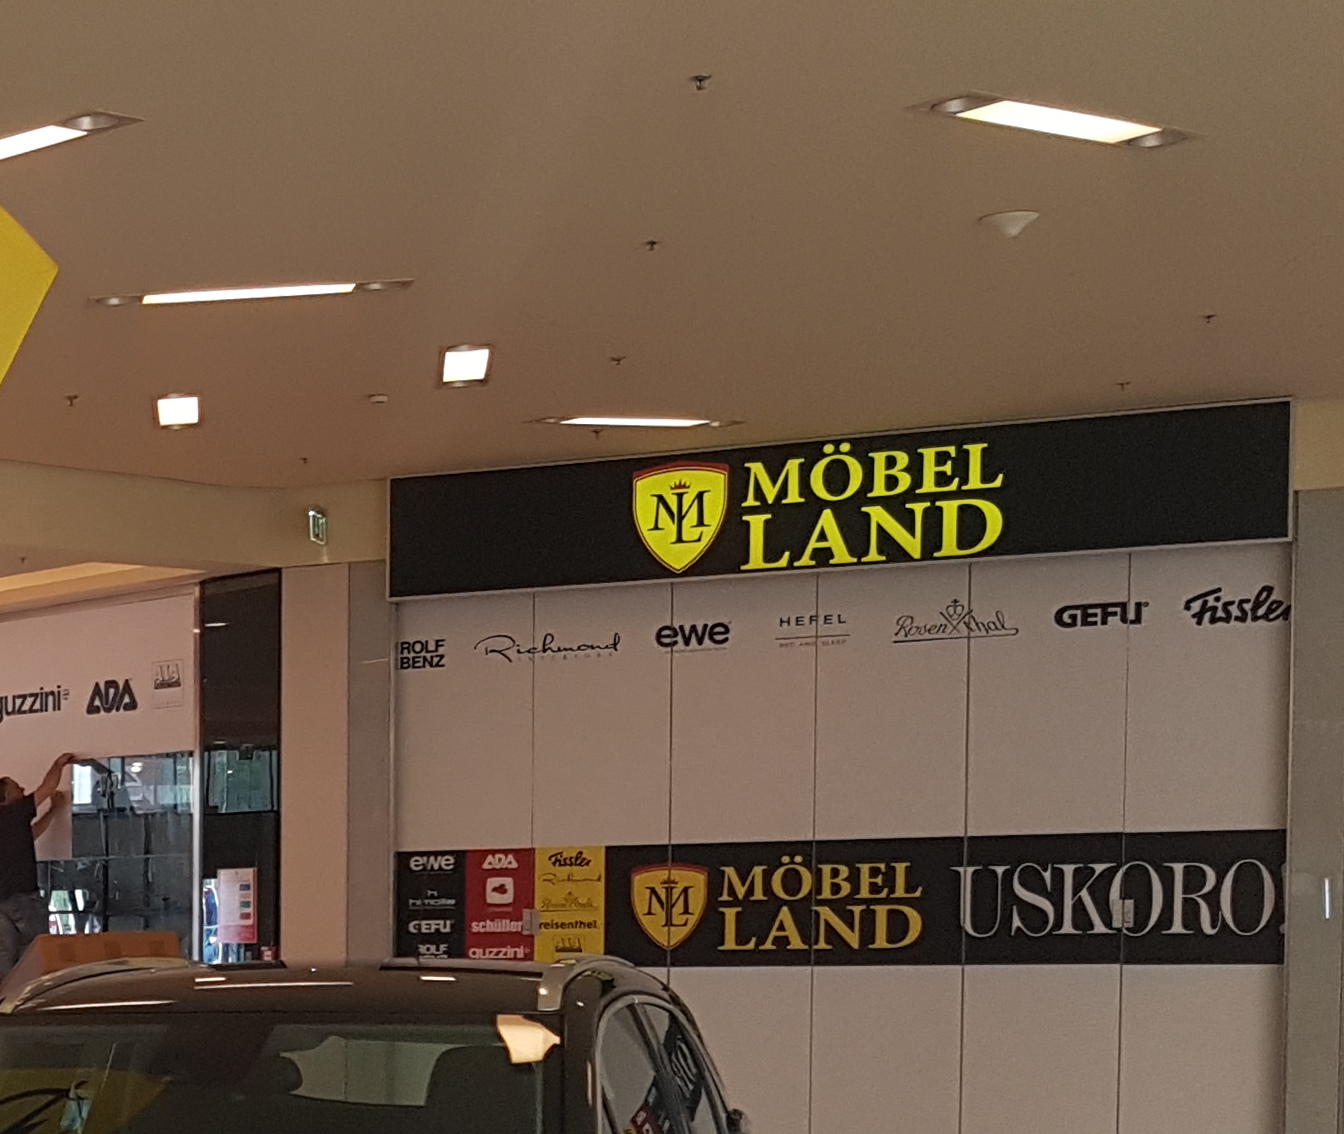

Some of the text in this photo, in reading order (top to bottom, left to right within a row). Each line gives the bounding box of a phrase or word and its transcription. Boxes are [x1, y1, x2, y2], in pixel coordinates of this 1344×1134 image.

[741, 442, 1004, 508] MÖBEL
[740, 498, 1004, 571] LAND
[779, 614, 847, 627] HEFEL
[1053, 601, 1143, 628] GEFU
[399, 639, 446, 655] ROLF
[474, 632, 621, 663] Richmond
[654, 622, 730, 648] ewe
[399, 655, 445, 670] BENZ
[86, 679, 139, 715] ADA
[409, 855, 454, 870] ewe
[482, 854, 518, 869] ADA
[718, 855, 923, 900] MÖBEL
[408, 920, 452, 934] GEFU
[539, 919, 598, 930] reisenthel
[717, 904, 924, 950] LAND
